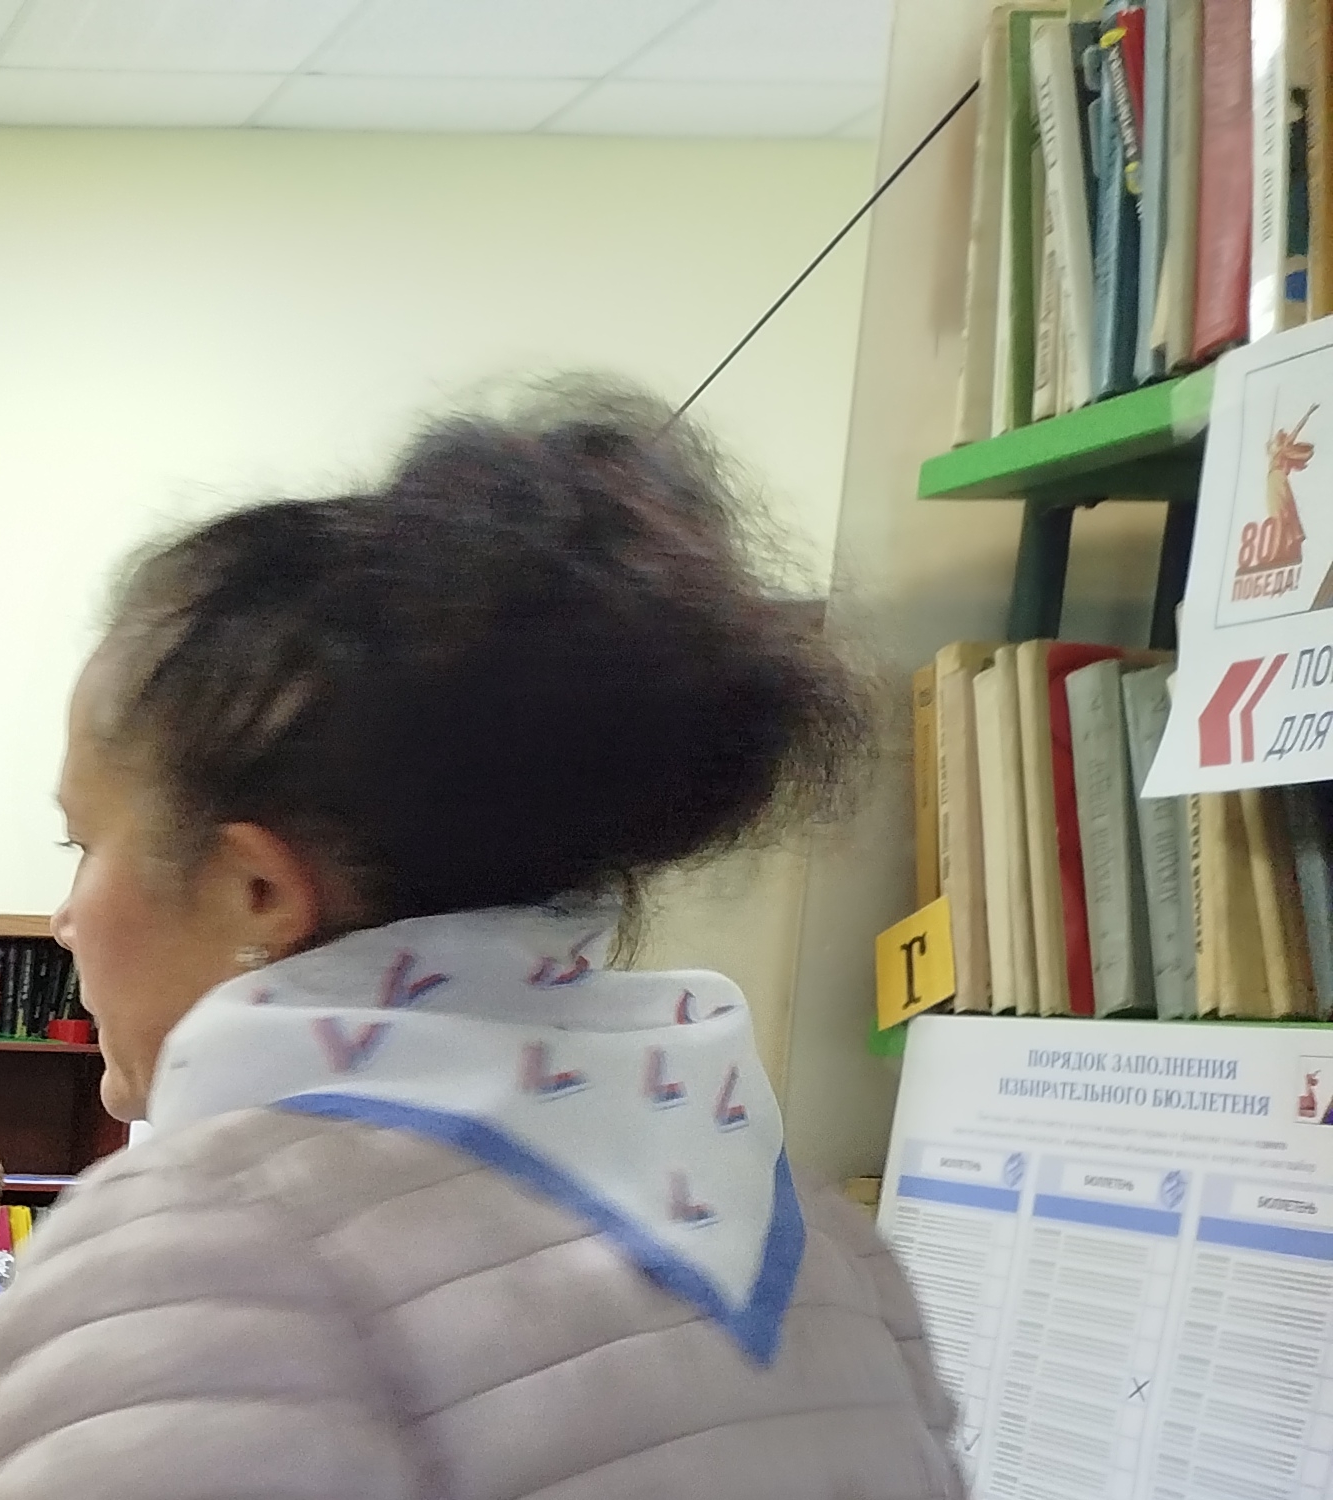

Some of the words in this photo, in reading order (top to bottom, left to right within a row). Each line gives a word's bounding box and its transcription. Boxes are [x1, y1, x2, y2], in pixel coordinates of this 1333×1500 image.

[1231, 565, 1302, 602] ПОБЕДА!
[1292, 643, 1333, 690] ПО
[1263, 710, 1333, 762] ДЛЯ
[1027, 1049, 1109, 1073] ПОРЯДОК
[1112, 1054, 1238, 1080] ЗАПОЛНЕНИЯ
[998, 1077, 1147, 1107] ИЗБИРАТЕЛЬНОГО
[1152, 1088, 1271, 1117] БЮЛЛЕТЕНЯ
